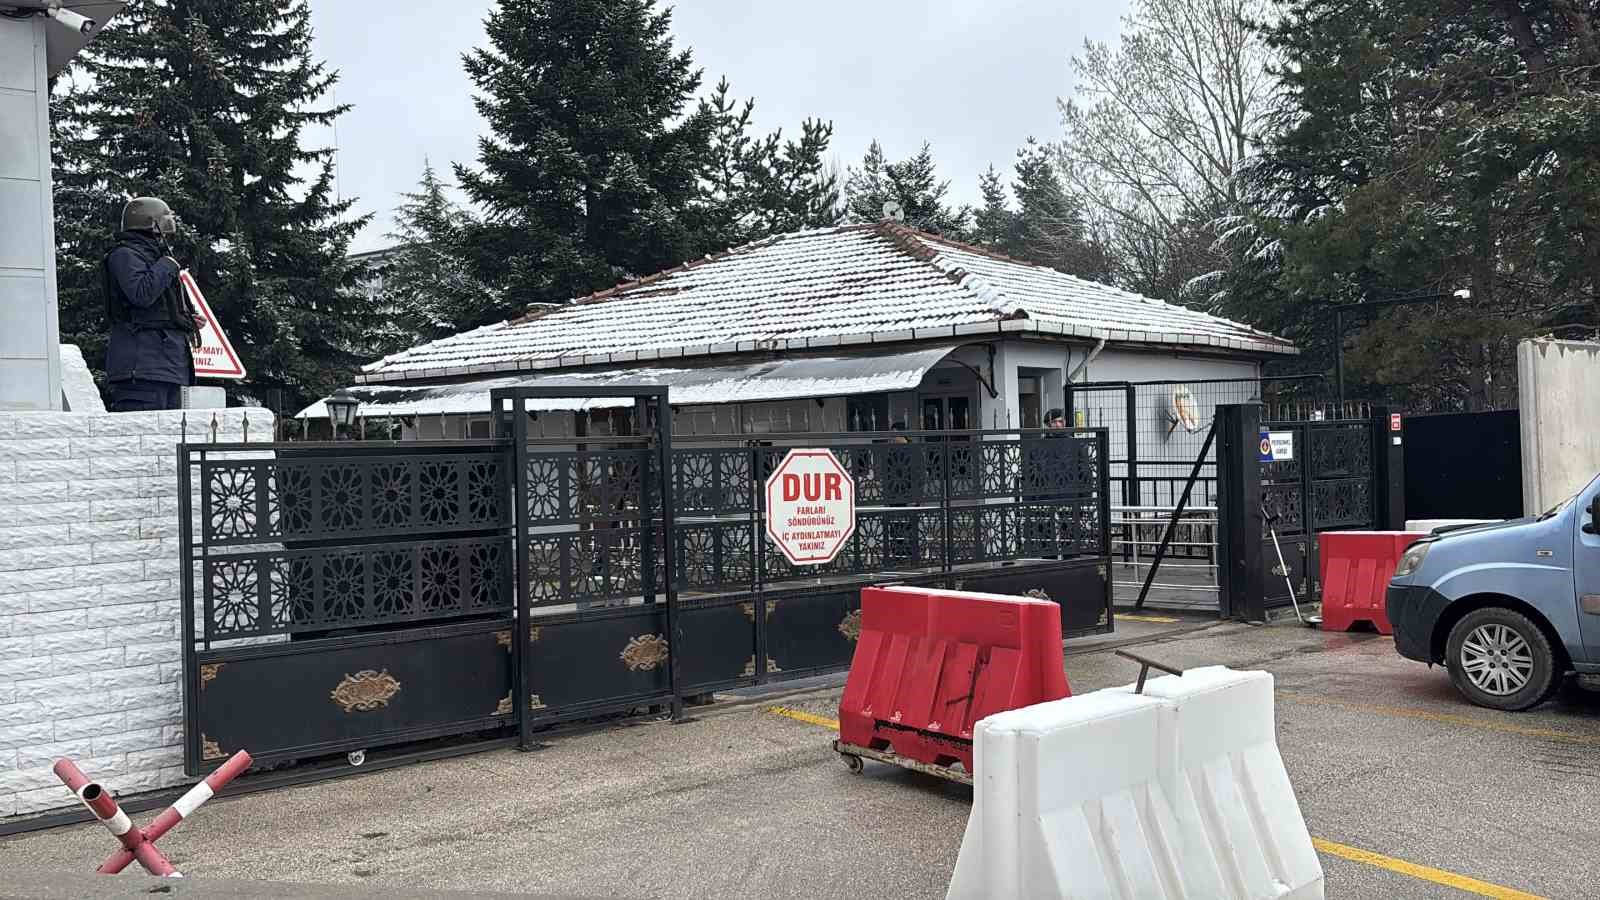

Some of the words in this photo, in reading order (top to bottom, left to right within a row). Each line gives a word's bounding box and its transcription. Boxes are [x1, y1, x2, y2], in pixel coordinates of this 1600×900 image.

[192, 346, 223, 355] APMAYI
[783, 473, 842, 501] DUR
[797, 506, 826, 515] FARLARI
[788, 515, 835, 527] SÖNDÜRÜNÜZ
[791, 530, 841, 540] AYDINLATMAYI
